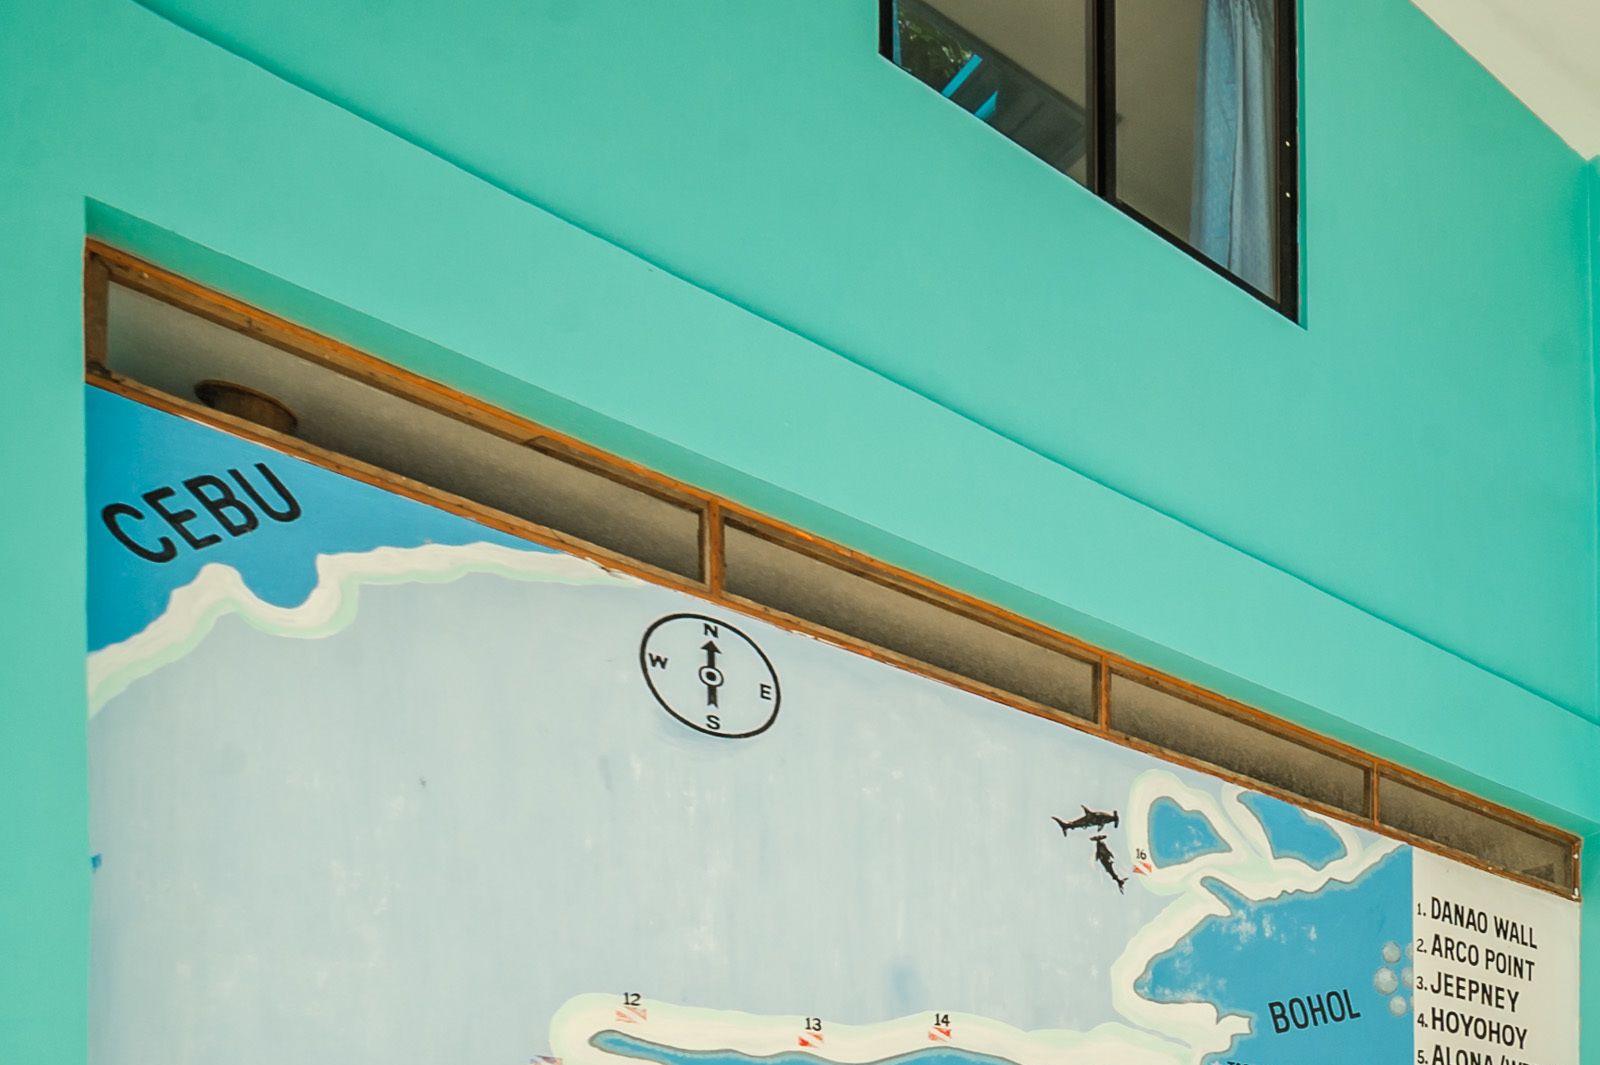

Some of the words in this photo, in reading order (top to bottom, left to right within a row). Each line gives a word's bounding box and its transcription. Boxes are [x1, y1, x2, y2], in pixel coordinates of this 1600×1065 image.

[100, 462, 302, 564] CEBU
[703, 623, 719, 639] N
[648, 652, 668, 670] W
[760, 683, 772, 701] E
[706, 714, 721, 730] S
[1135, 848, 1147, 861] 16
[1417, 902, 1427, 917] 1.
[1431, 896, 1488, 934] DANAO
[1493, 915, 1538, 950] WALL
[1416, 938, 1428, 954] 2.
[1431, 933, 1479, 967] ARCO
[1485, 948, 1535, 982] POINT
[623, 992, 641, 1007] 12
[1416, 975, 1428, 991] 3.
[1431, 971, 1519, 1013] JEEPNEY
[934, 1013, 951, 1027] 14
[1268, 989, 1361, 1034] BOHOL
[805, 1017, 822, 1032] 13
[1416, 1012, 1429, 1028] 4.
[1431, 1006, 1528, 1050] HOYOHOY
[1417, 1049, 1429, 1065] 5.
